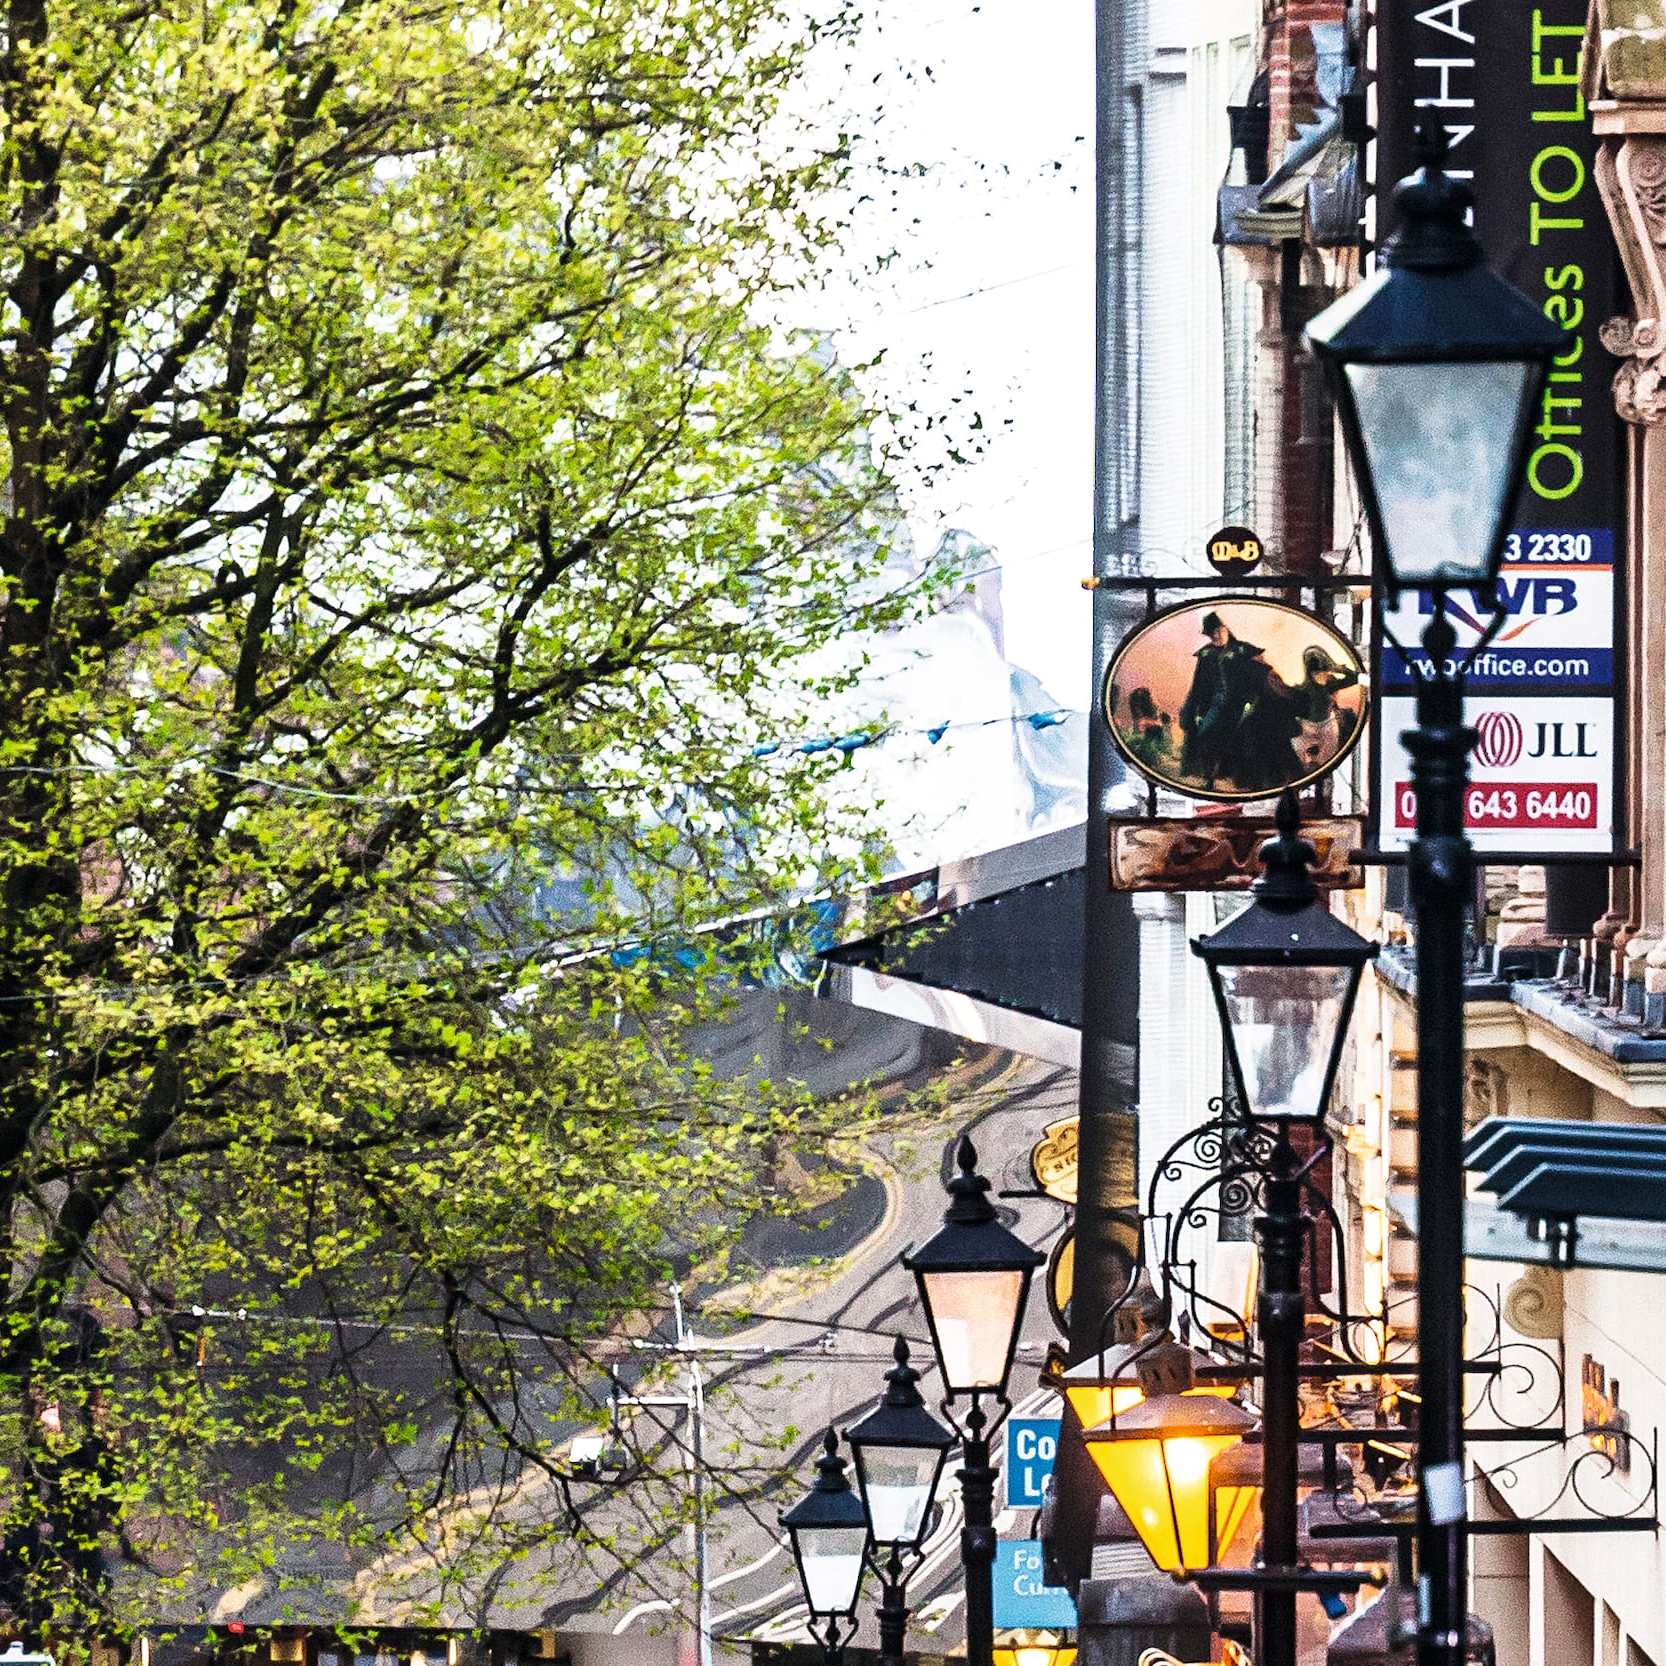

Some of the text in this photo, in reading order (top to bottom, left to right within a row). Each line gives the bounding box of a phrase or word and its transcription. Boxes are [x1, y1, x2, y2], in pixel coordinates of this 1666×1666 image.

[1531, 9, 1586, 122] LET
[1530, 145, 1585, 246] TO
[1528, 533, 1591, 562] 2330
[1527, 722, 1598, 758] JLL
[1468, 791, 1591, 819] 643 6440
[1016, 1428, 1057, 1461] Co
[1013, 1549, 1041, 1571] Fo
